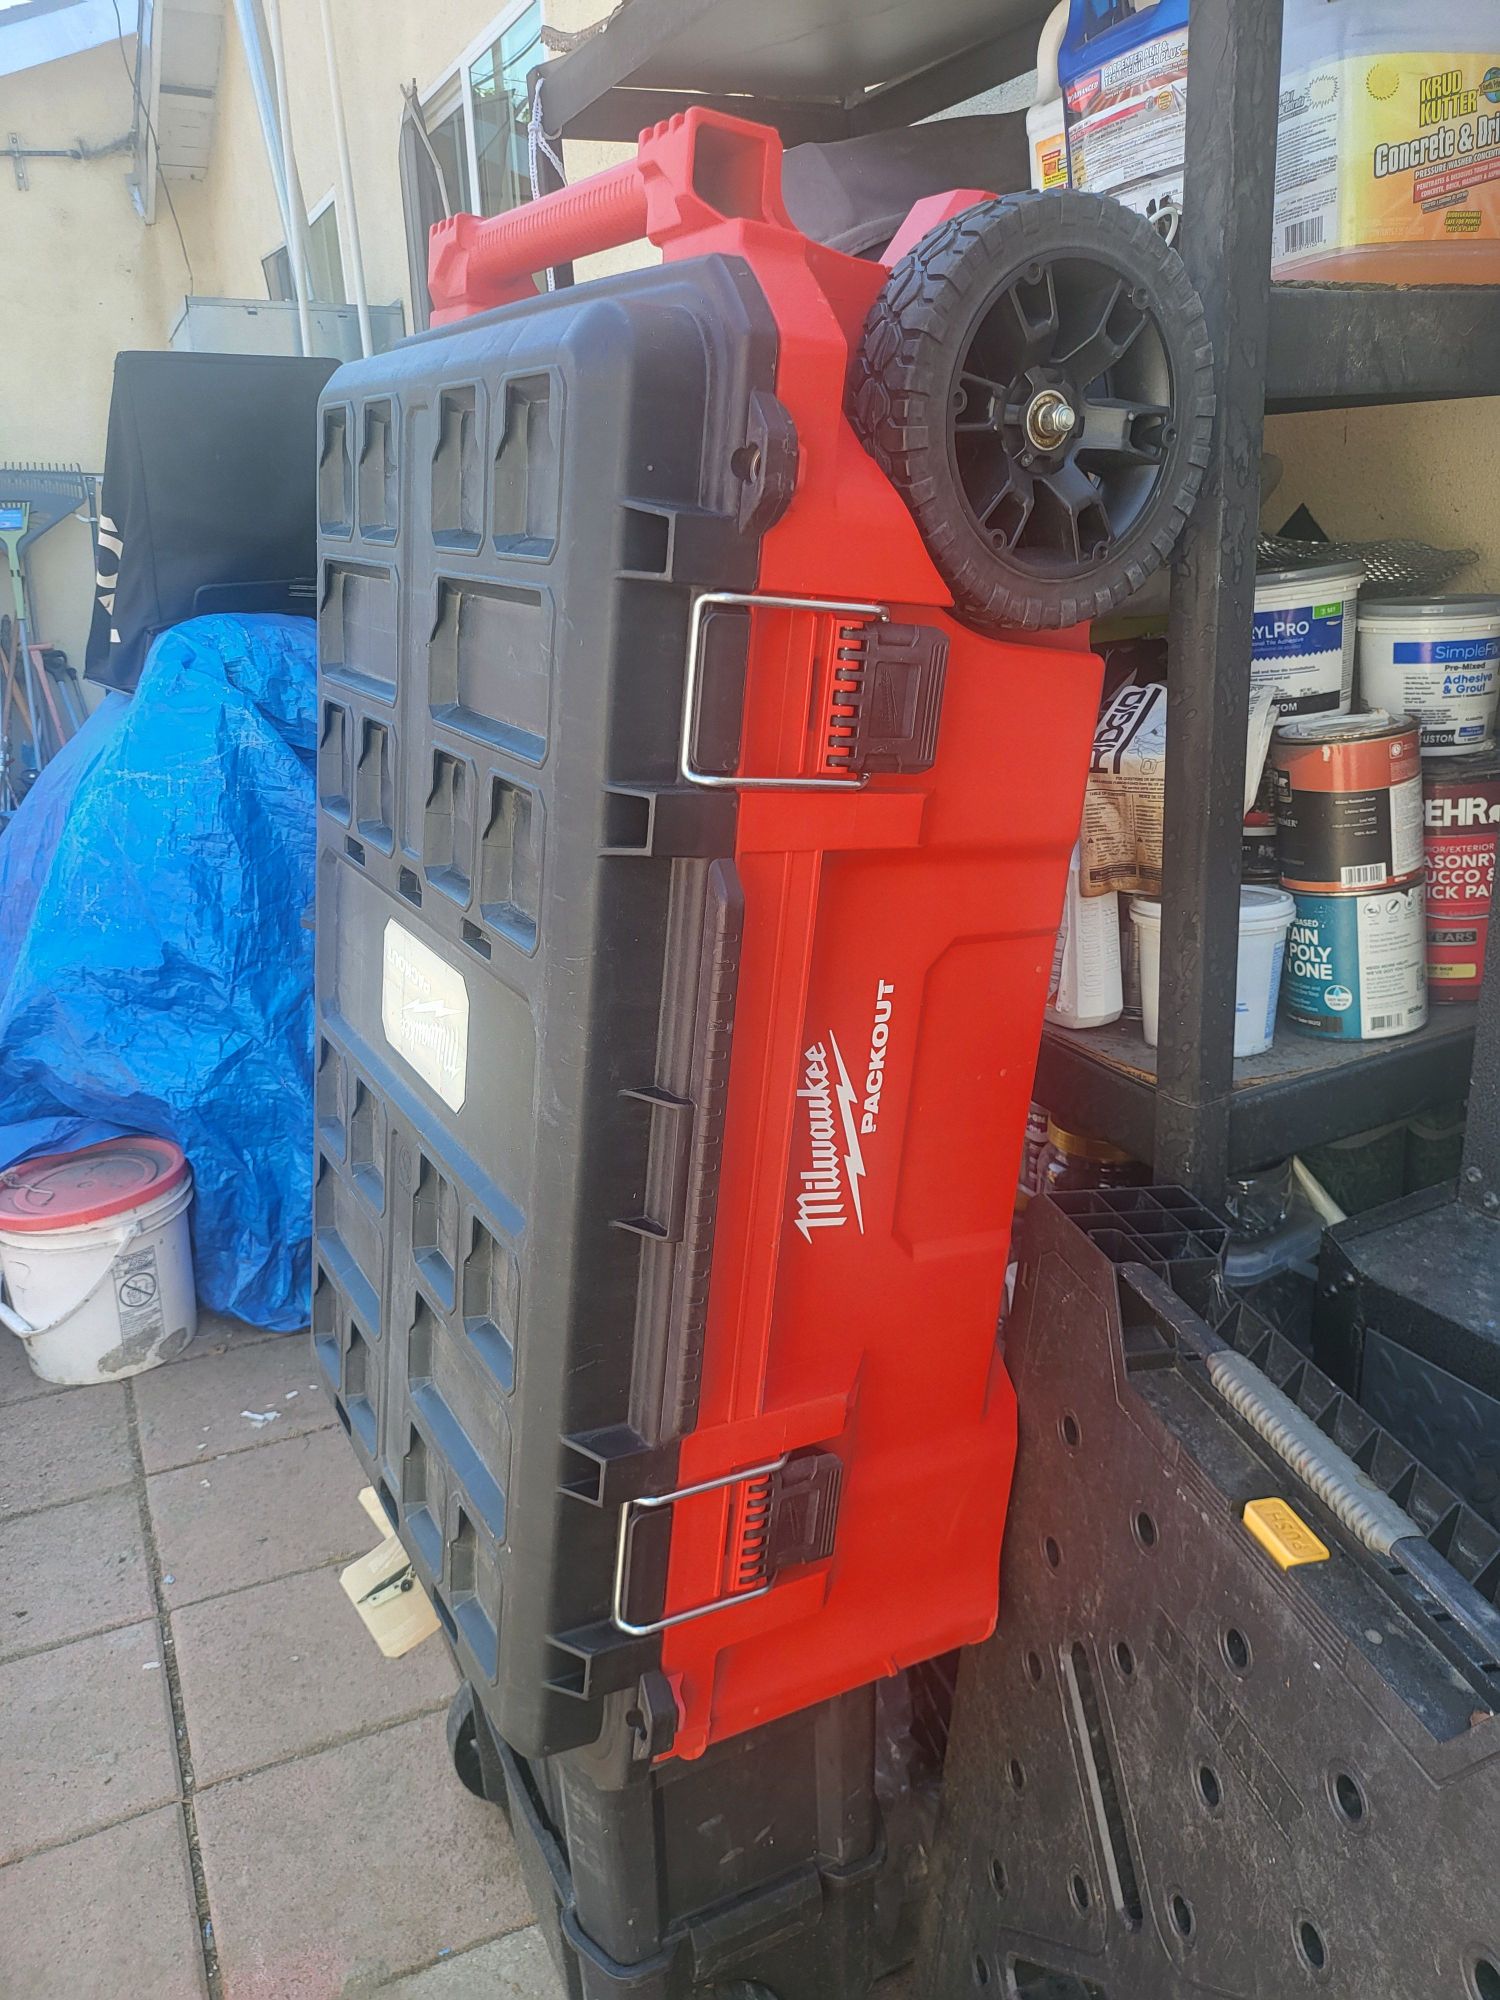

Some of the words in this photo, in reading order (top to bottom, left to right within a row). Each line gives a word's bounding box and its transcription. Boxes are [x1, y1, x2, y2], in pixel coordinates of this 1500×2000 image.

[1103, 49, 1144, 77] CARPENTER
[1144, 43, 1160, 58] ANT
[1104, 66, 1133, 86] TERMITE
[1132, 55, 1159, 74] KILLER
[1160, 46, 1182, 64] PLUS
[1420, 70, 1462, 103] KRUD
[1419, 89, 1478, 128] KUTTER
[1374, 126, 1455, 179] Concrete
[1458, 122, 1474, 154] &
[1414, 164, 1447, 180] PRESSURE
[1447, 156, 1473, 171] WASHER
[1443, 672, 1493, 684] Adhesive
[1444, 662, 1486, 671] Pre-Mixed
[1442, 685, 1452, 694] &
[1455, 683, 1486, 693] Grout
[1089, 690, 1147, 774] RIDGID
[1290, 942, 1332, 963] POLY
[1294, 960, 1333, 980] ONE
[386, 952, 432, 995] PACKOUT
[400, 1018, 462, 1080] Milwaukee
[860, 979, 894, 1134] PACKOUT
[794, 1042, 848, 1244] Milwaukee
[1264, 1511, 1312, 1549] PUSH
